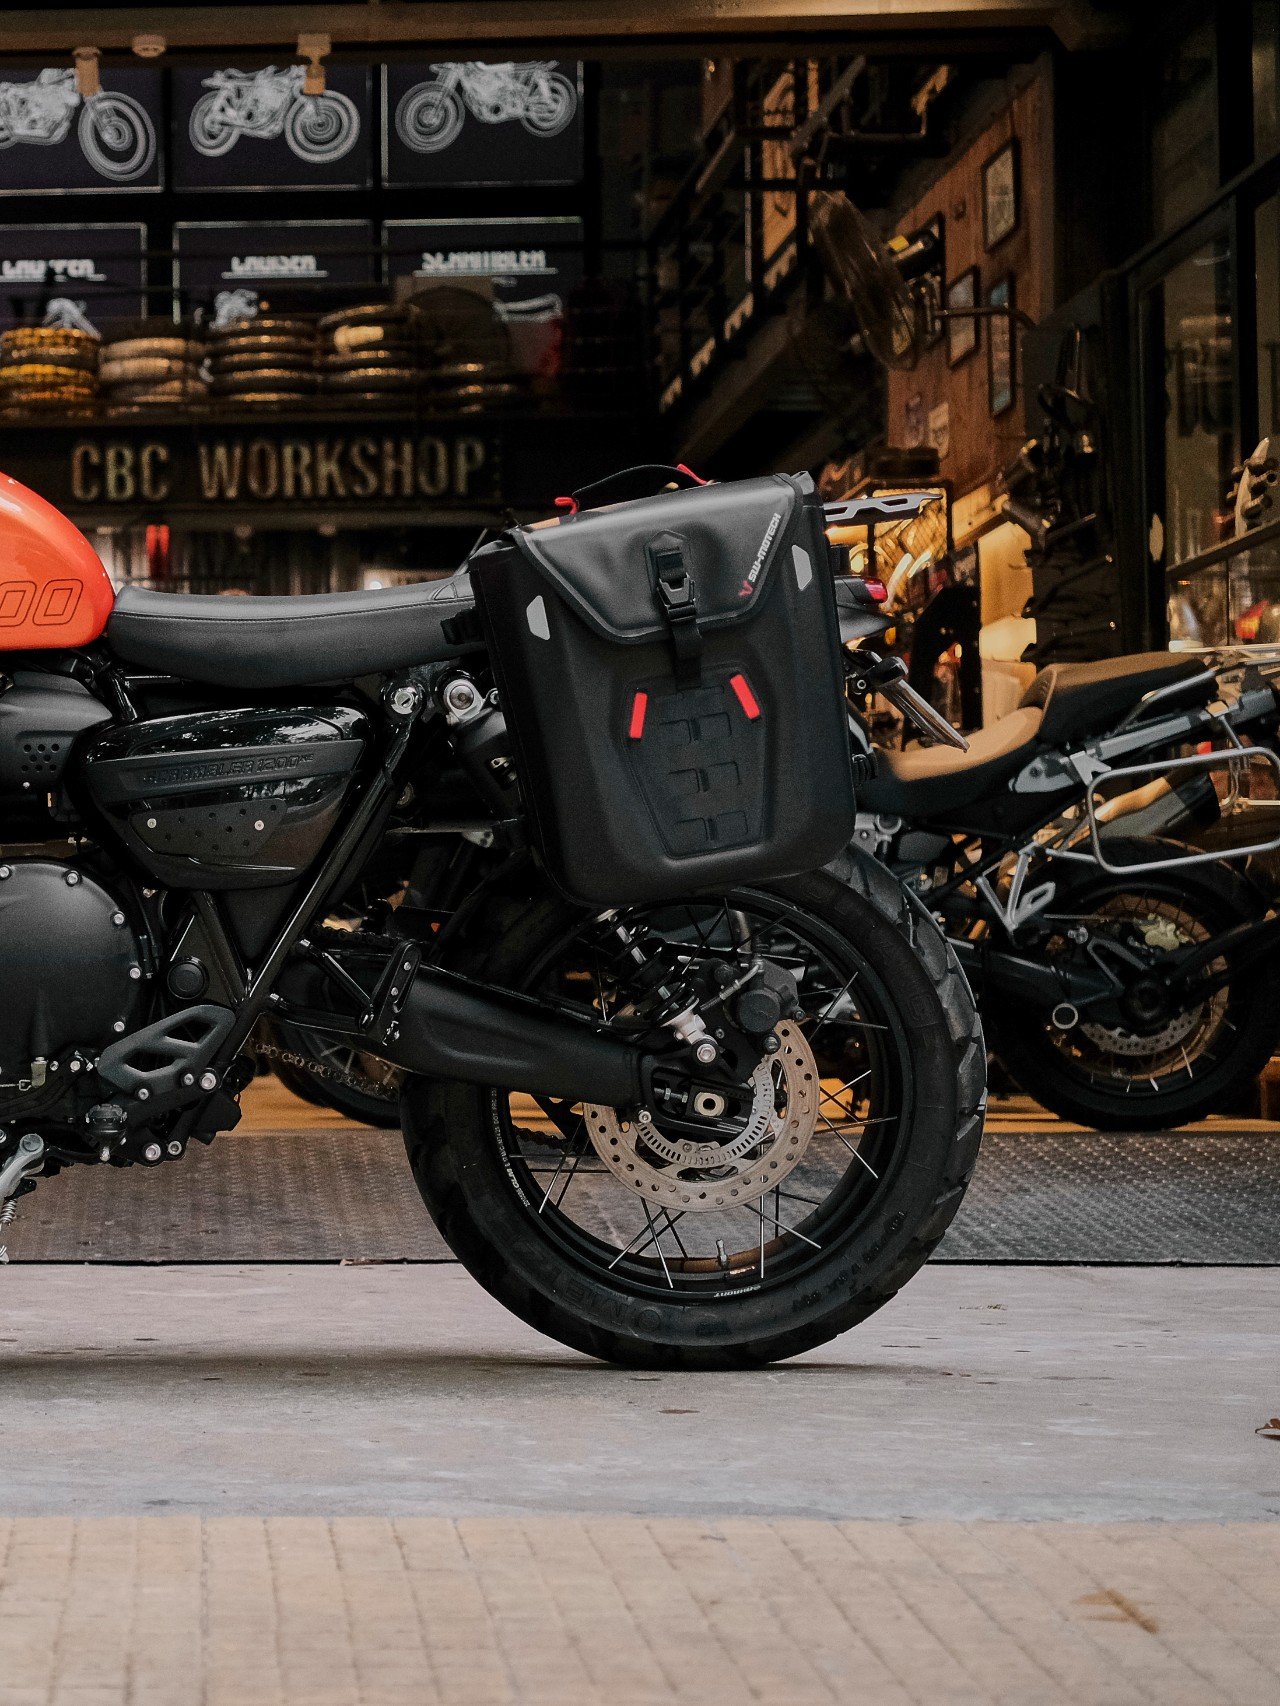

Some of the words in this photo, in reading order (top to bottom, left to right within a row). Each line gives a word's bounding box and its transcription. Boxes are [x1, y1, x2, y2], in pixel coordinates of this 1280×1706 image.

[70, 441, 170, 500] CBC
[198, 438, 486, 499] WORKSHOP
[748, 512, 782, 583] SW-MOTECH
